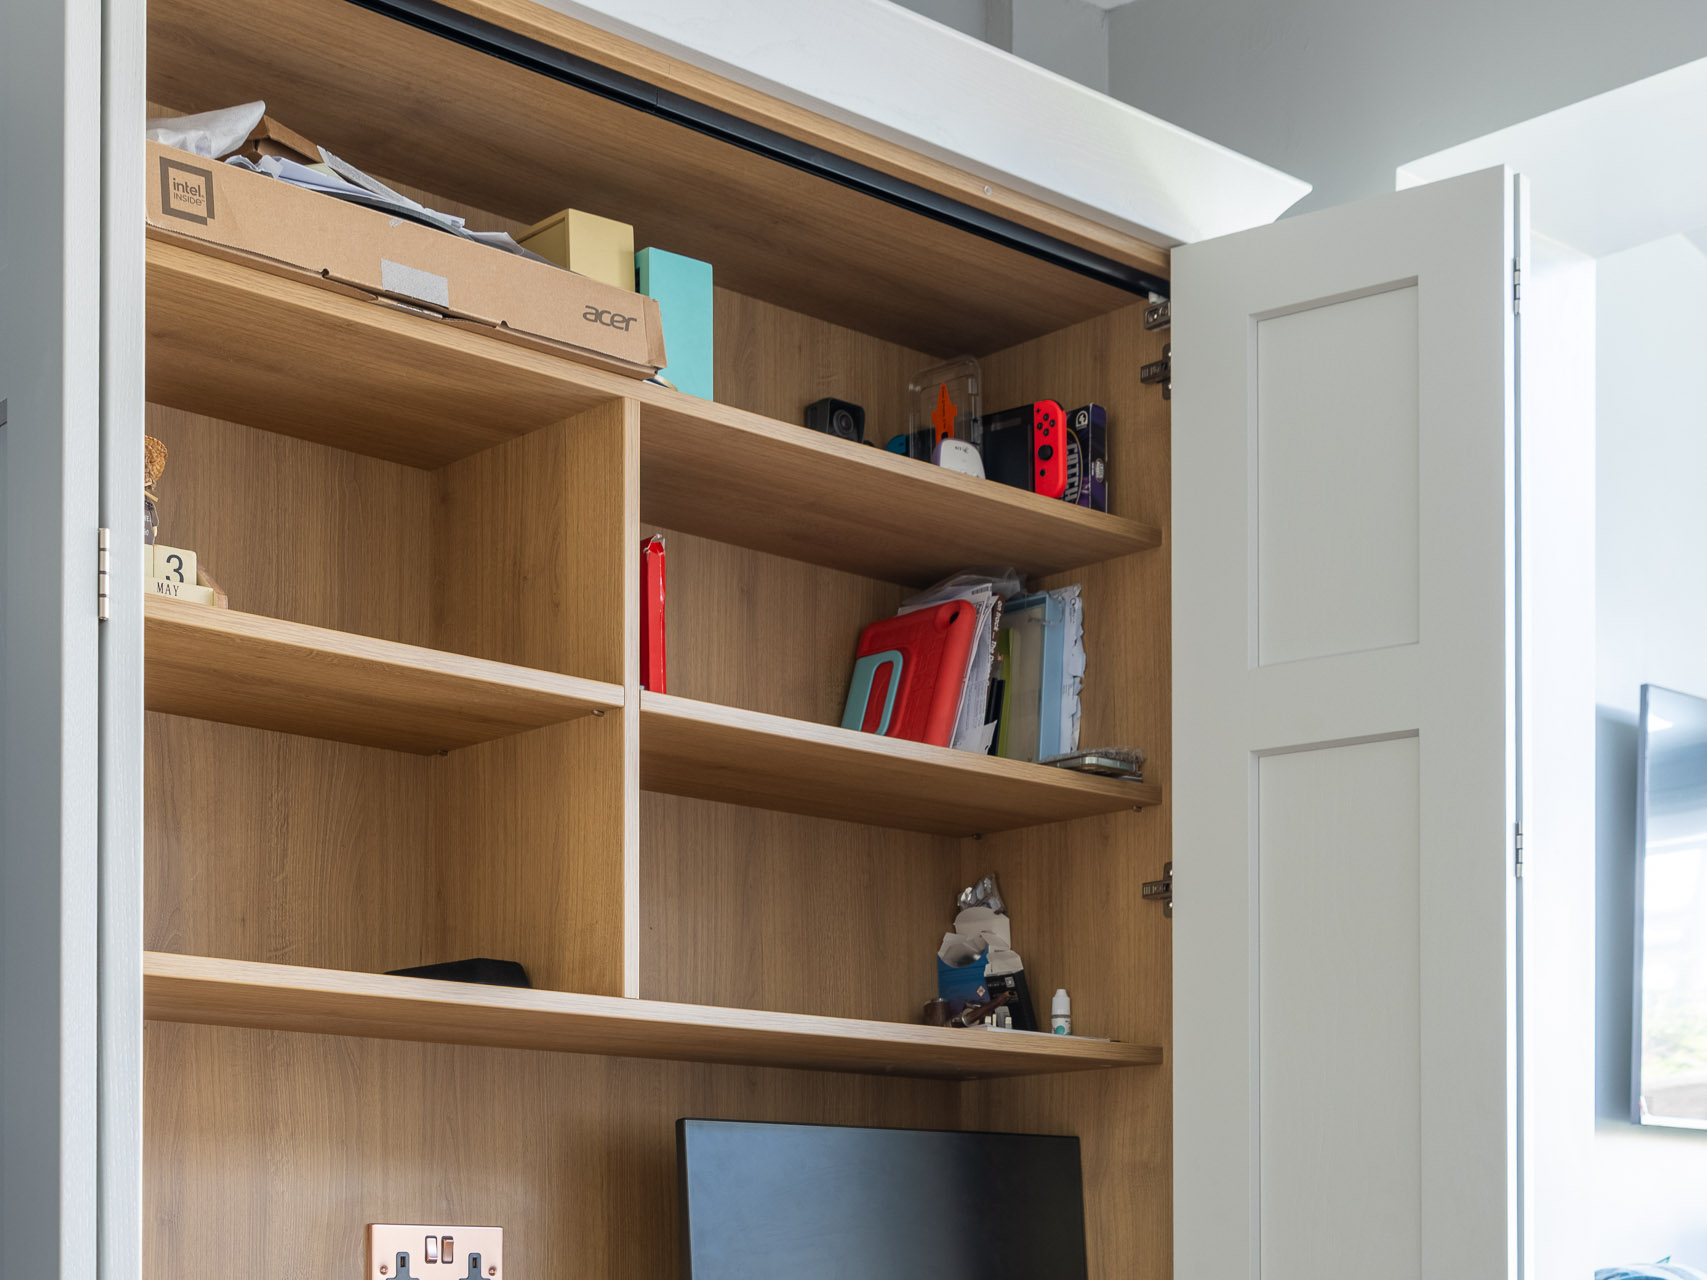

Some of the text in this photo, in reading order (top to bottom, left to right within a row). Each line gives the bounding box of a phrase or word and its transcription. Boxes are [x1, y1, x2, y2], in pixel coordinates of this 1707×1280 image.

[173, 177, 202, 198] intel
[582, 305, 638, 332] acer
[165, 554, 185, 583] 3
[156, 582, 180, 597] MAY
